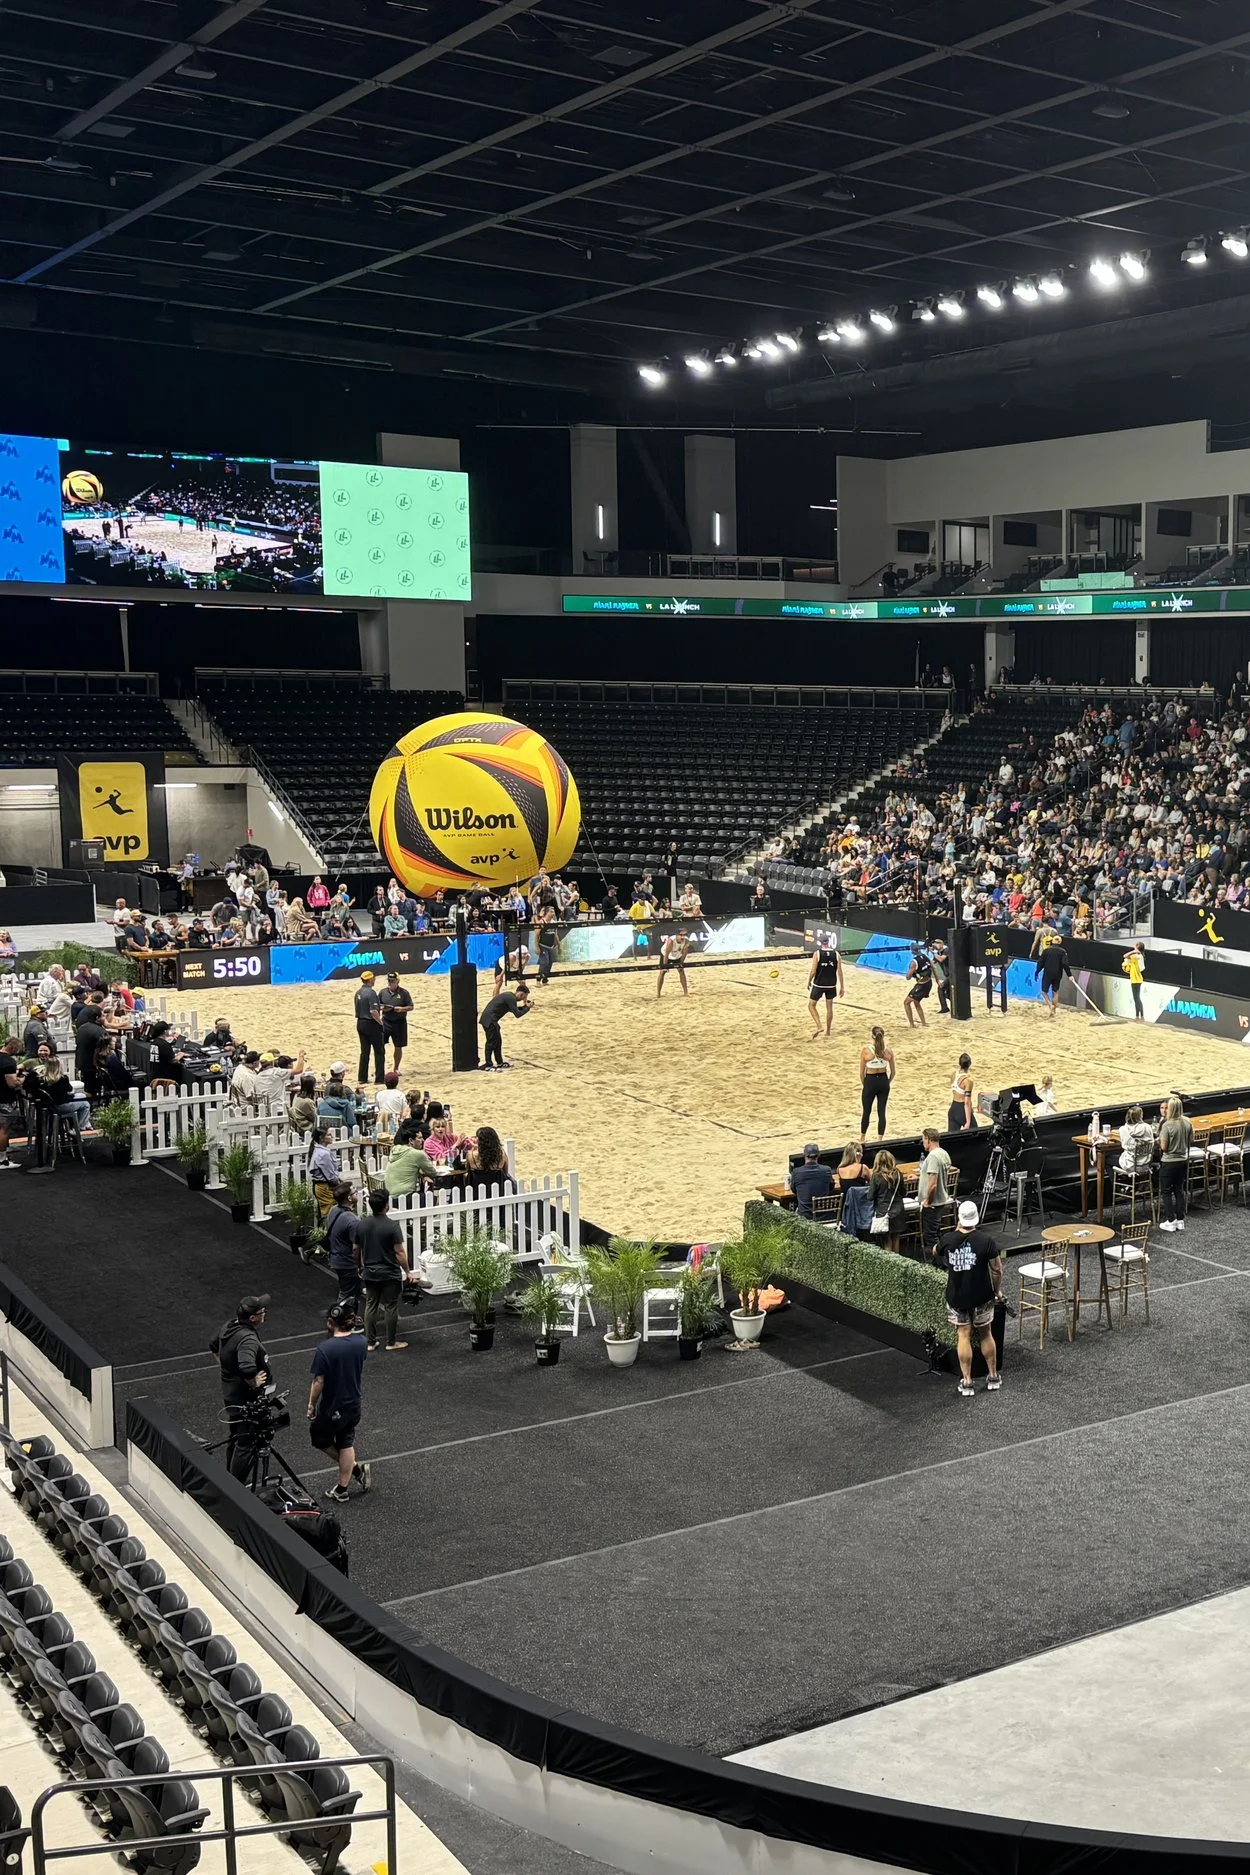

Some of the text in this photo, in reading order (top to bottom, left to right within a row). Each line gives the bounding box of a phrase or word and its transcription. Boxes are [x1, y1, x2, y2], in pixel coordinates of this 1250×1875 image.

[425, 807, 516, 831] Wilson
[470, 854, 500, 866] avp
[423, 950, 440, 960] LA
[985, 948, 1002, 957] avp
[214, 956, 261, 978] 5:50
[183, 970, 205, 978] MATCH
[1238, 1015, 1249, 1028] VS
